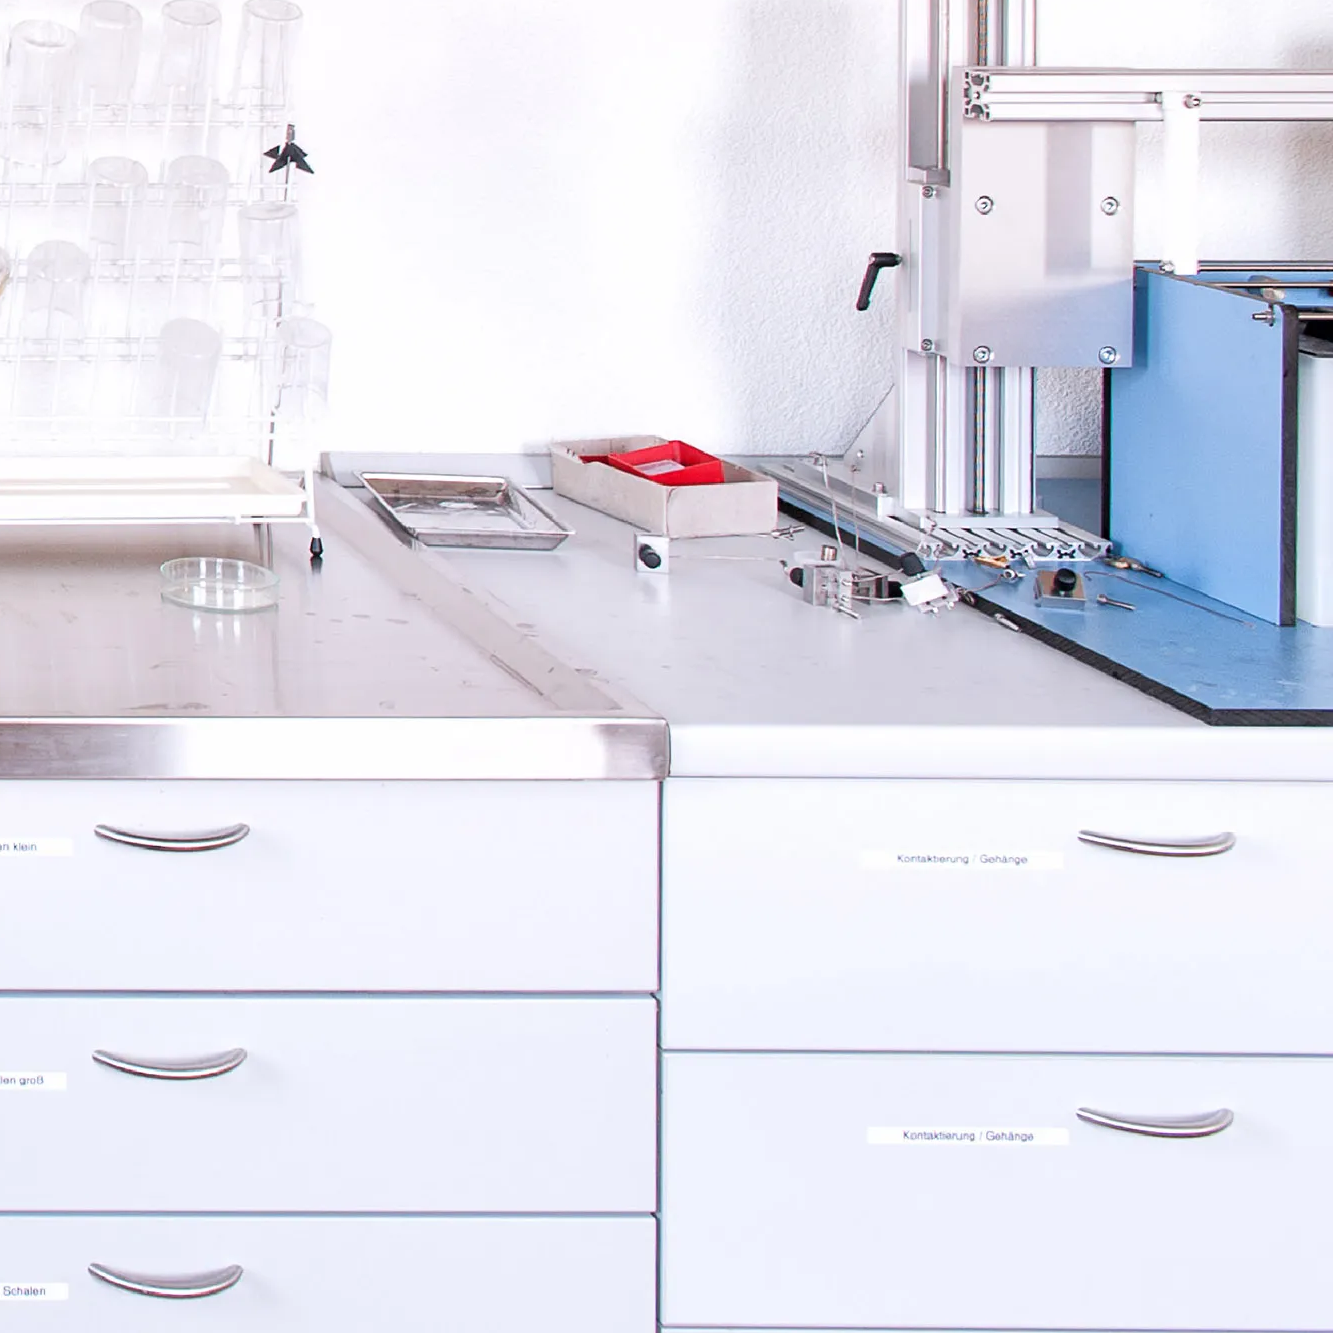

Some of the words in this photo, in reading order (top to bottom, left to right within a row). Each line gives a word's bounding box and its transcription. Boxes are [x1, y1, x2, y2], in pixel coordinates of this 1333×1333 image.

[13, 841, 38, 852] klein
[897, 854, 970, 866] Kontaktierung
[902, 1130, 976, 1142] Kontaktierung
[2, 1285, 46, 1296] Schalen
